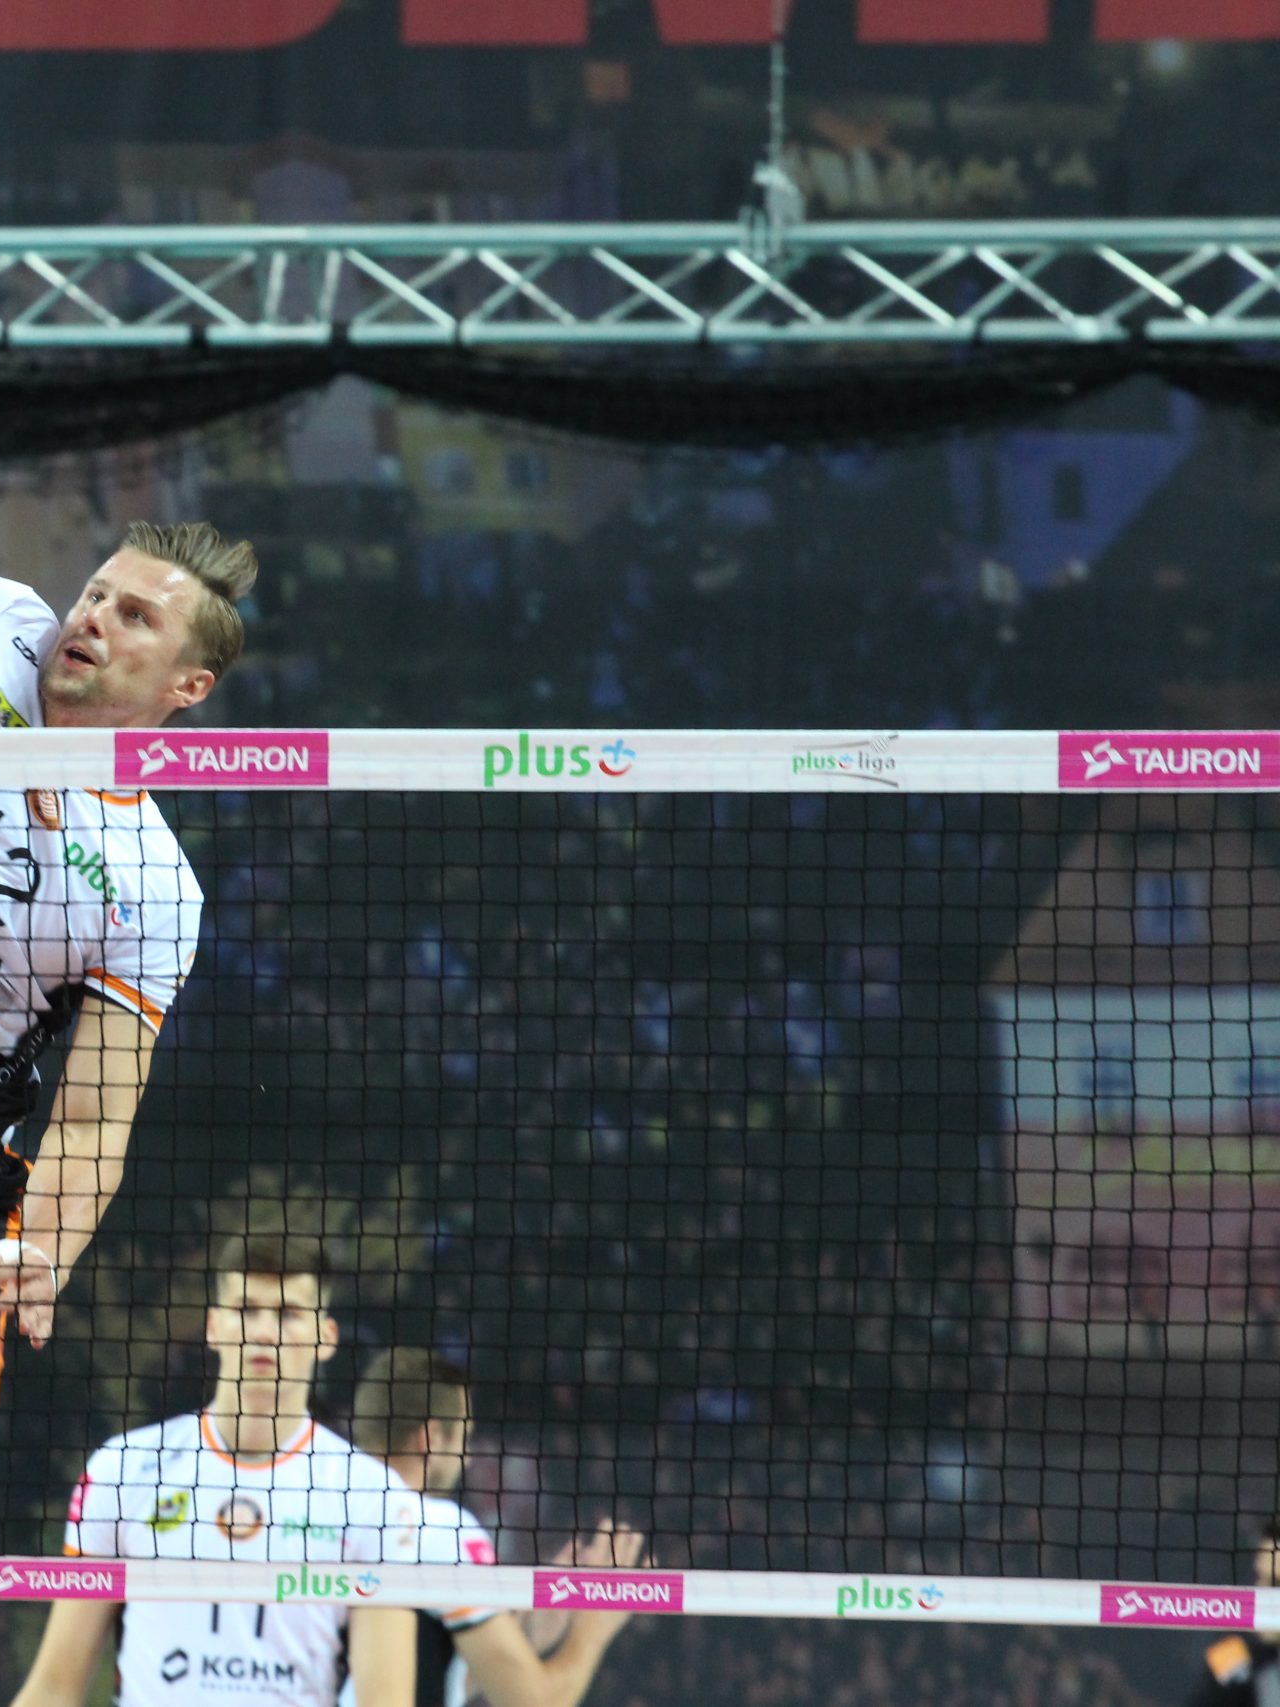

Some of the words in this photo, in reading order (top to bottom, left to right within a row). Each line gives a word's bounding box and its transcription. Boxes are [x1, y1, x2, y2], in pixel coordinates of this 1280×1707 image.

[182, 745, 310, 773] TAURON
[482, 729, 593, 788] plus
[1127, 747, 1261, 775] TAURON
[24, 1570, 113, 1592] TAURON
[275, 1564, 351, 1602] plus
[580, 1581, 671, 1604] TAURON
[835, 1577, 914, 1617] plus
[1148, 1594, 1242, 1620] TAURON
[202, 1654, 295, 1684] KGHM
